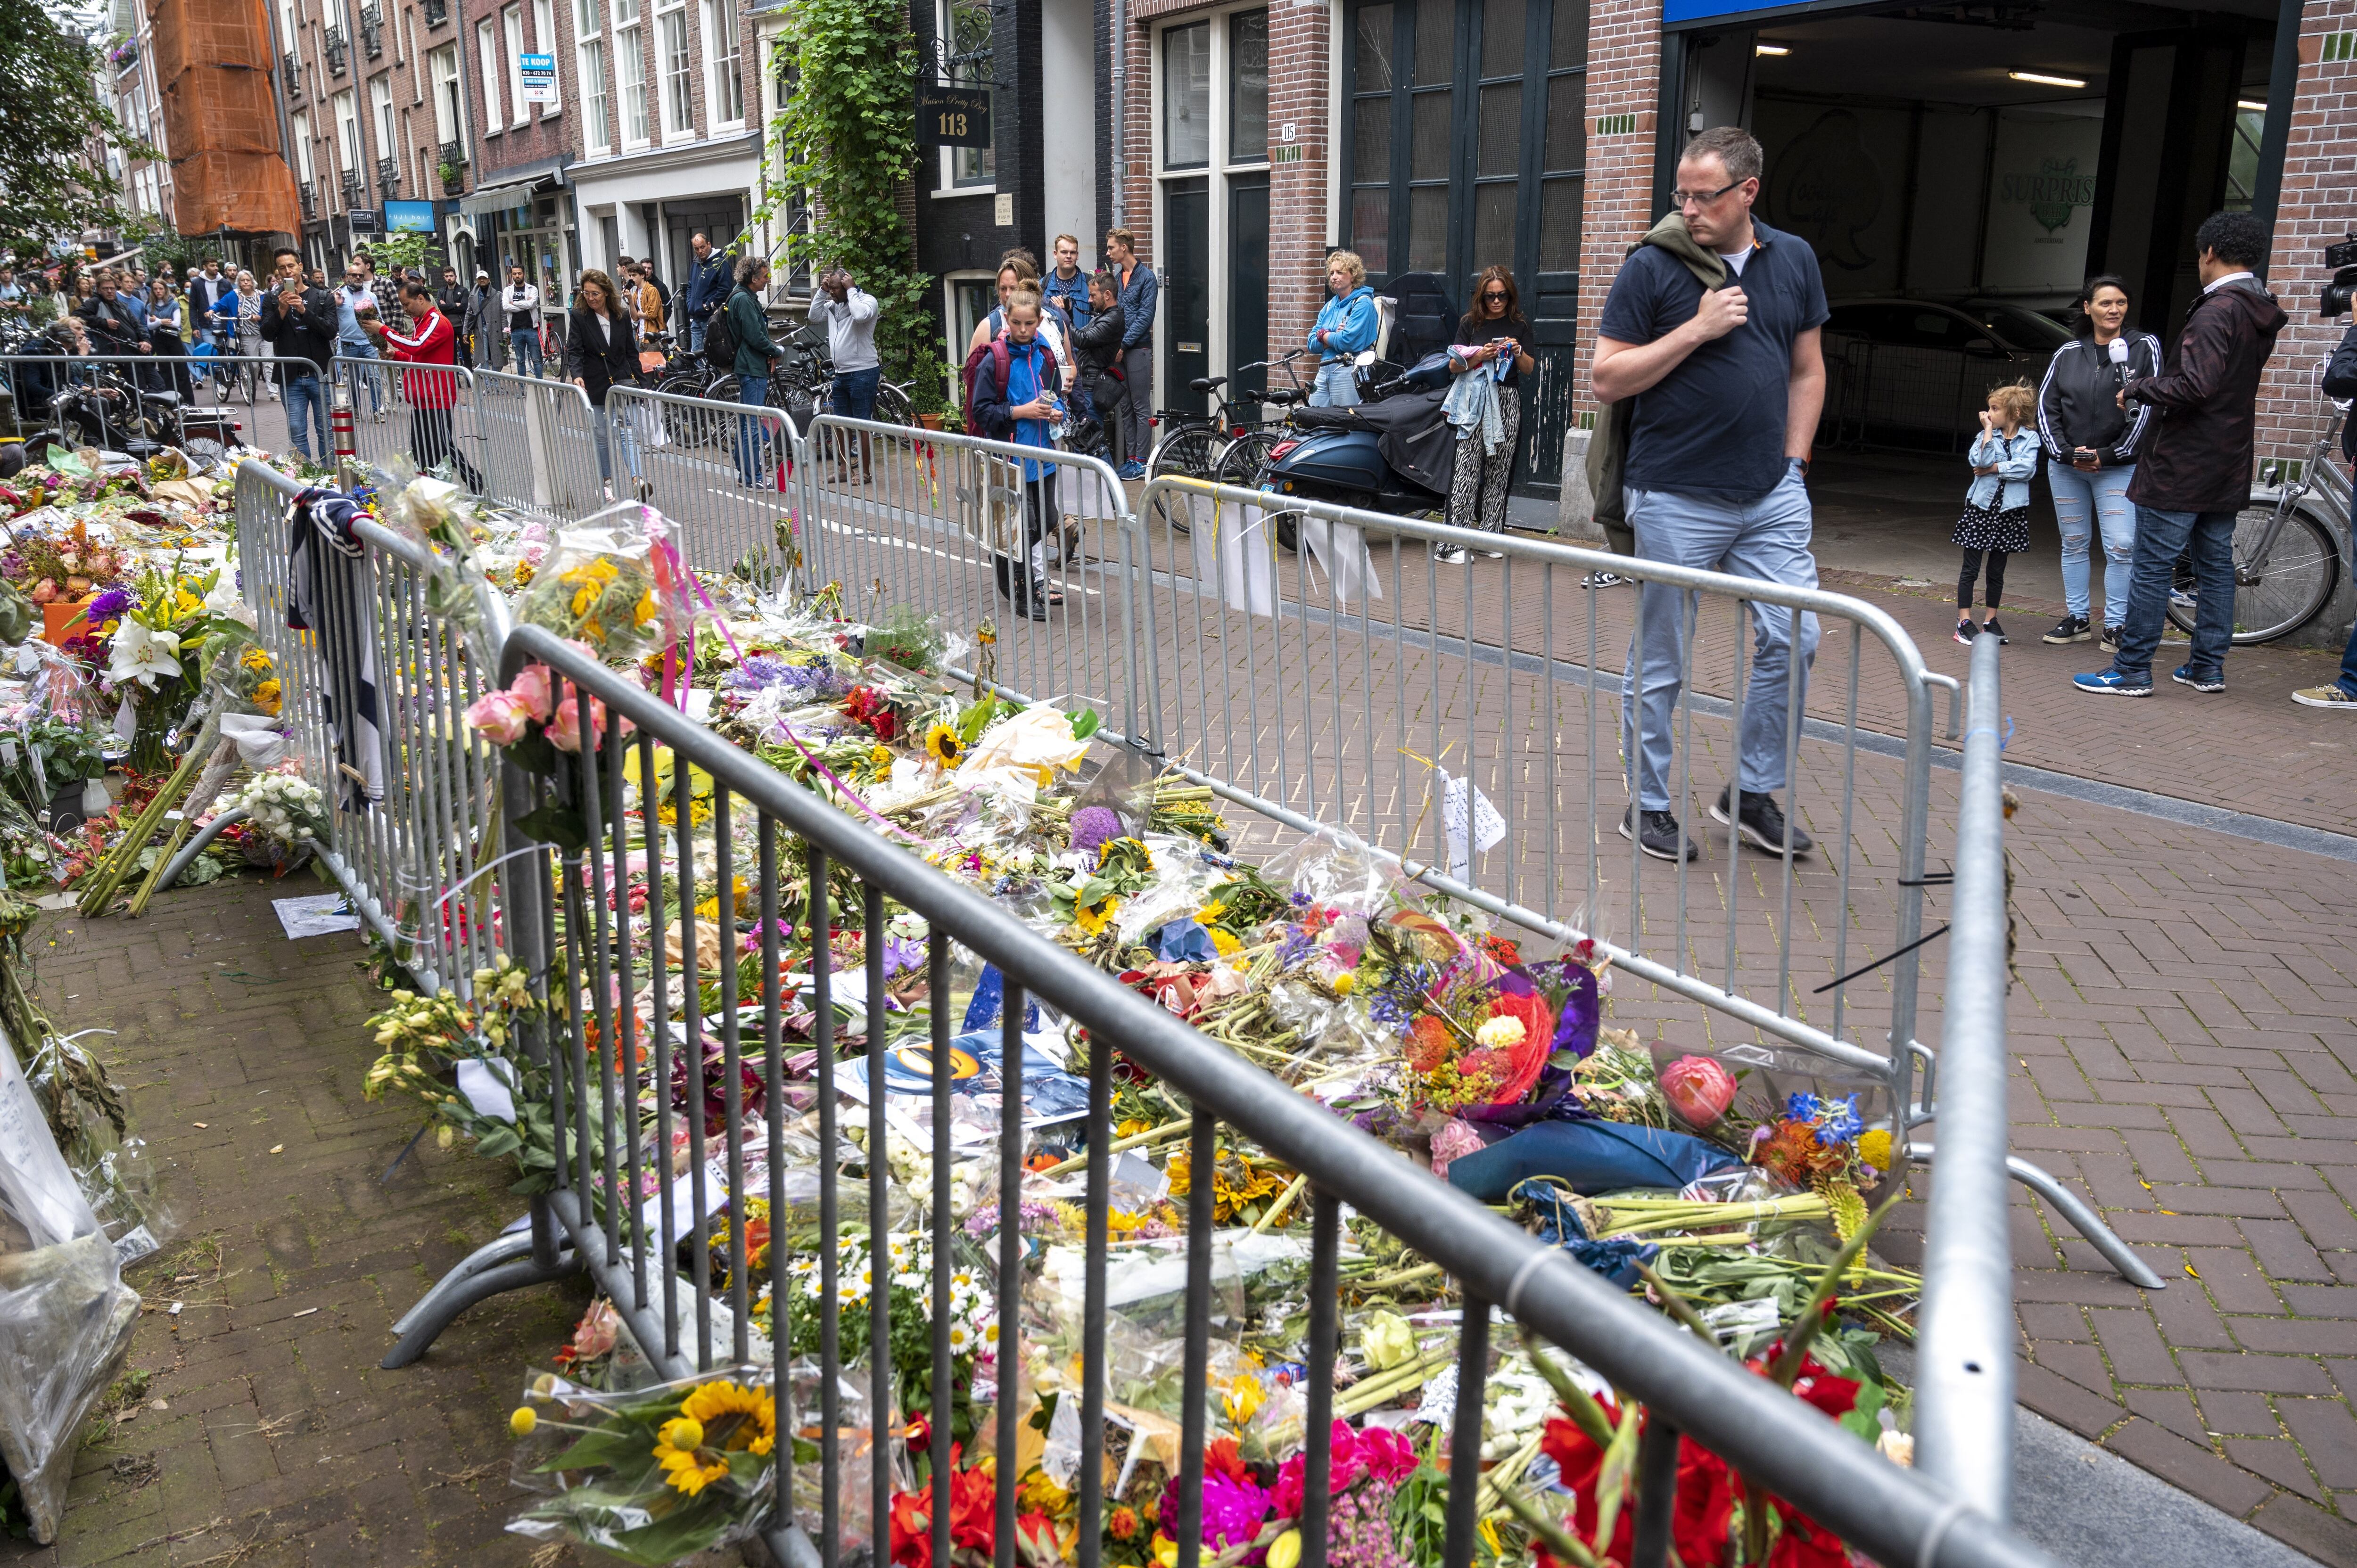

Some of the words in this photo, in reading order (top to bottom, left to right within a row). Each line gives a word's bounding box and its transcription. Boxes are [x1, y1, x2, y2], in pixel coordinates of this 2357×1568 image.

[531, 58, 551, 66] KOOP
[917, 94, 944, 107] Maison
[947, 94, 969, 109] Pretty
[970, 99, 988, 114] Boy
[939, 112, 967, 136] 113
[1285, 125, 1294, 139] 115
[2002, 172, 2096, 204] SURPRIS
[2041, 205, 2063, 219] BAR
